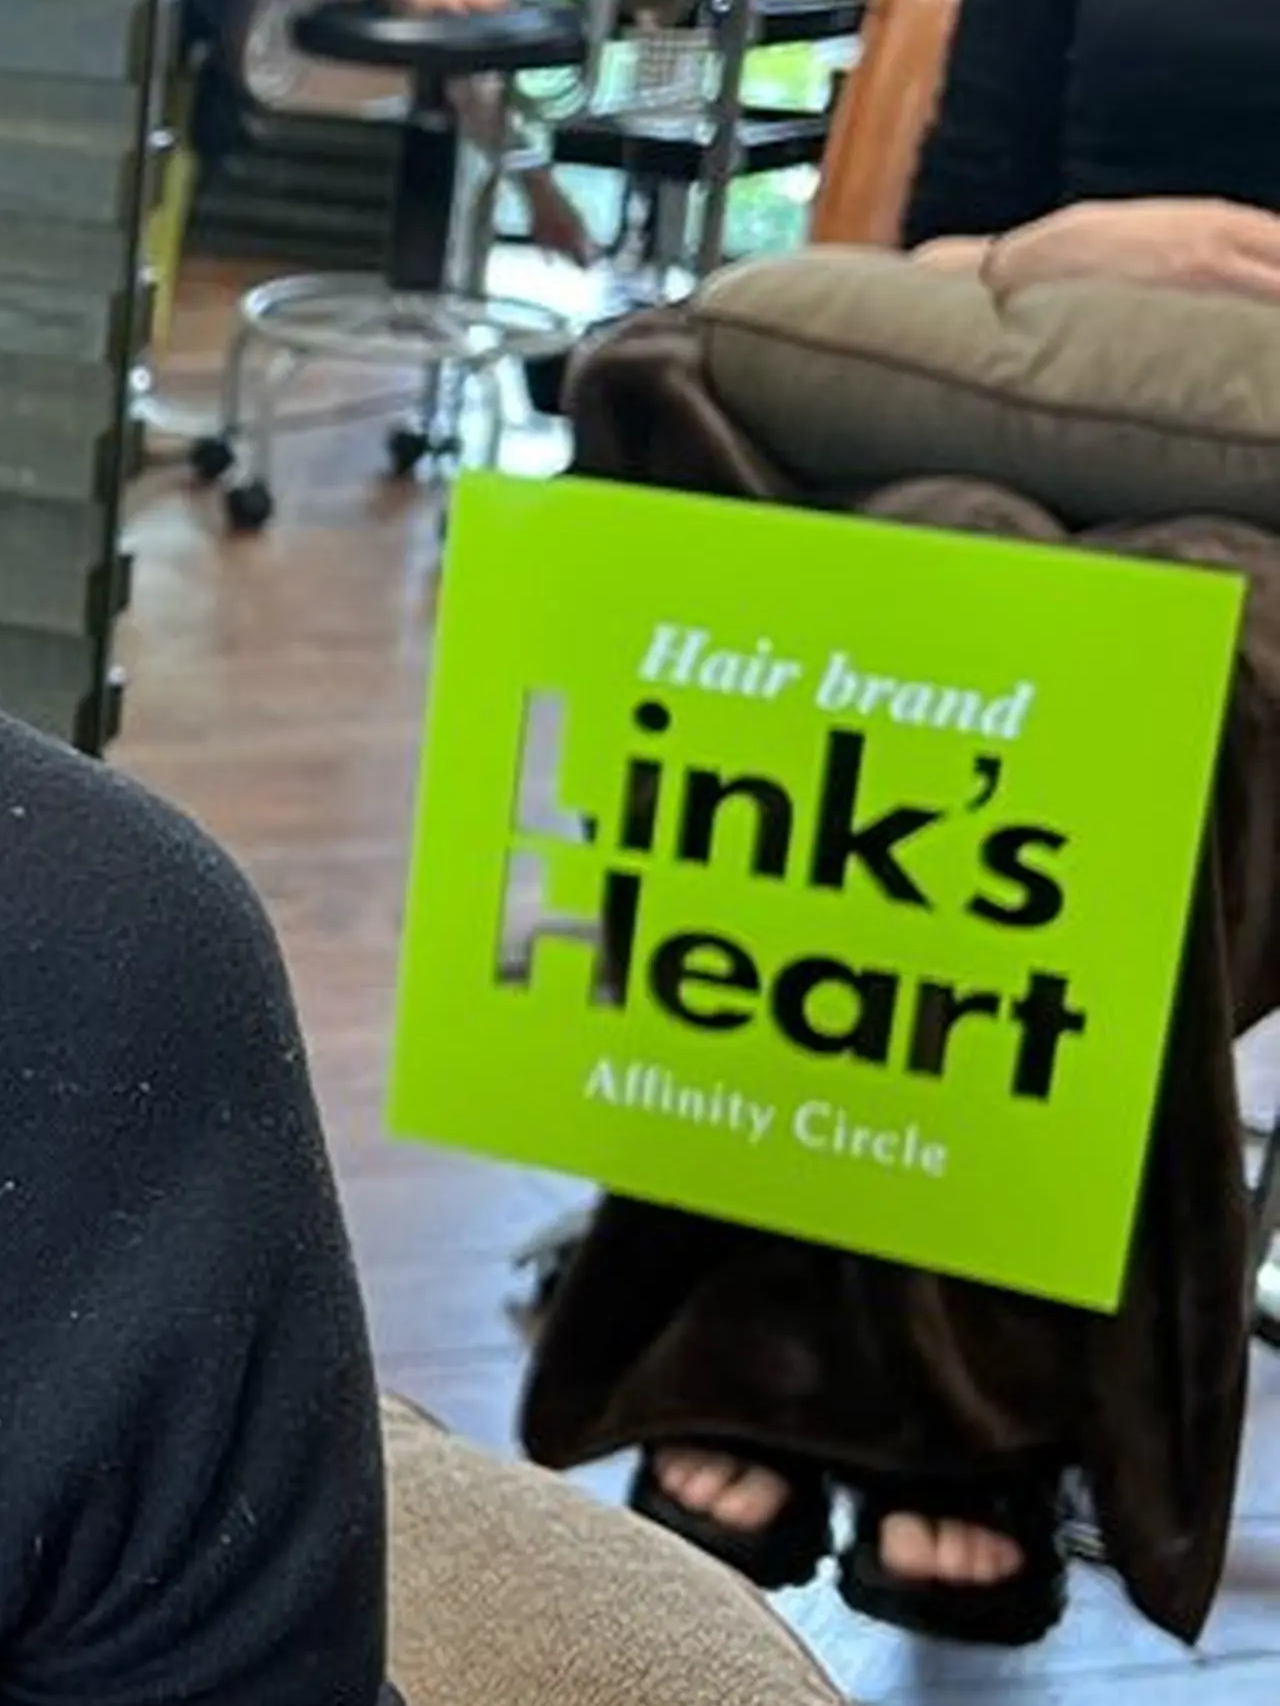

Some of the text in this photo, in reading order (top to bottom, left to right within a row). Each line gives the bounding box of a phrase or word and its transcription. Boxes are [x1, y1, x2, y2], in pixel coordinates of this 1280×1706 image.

[639, 623, 1035, 740] Hair brand
[514, 689, 1072, 929] Link's
[493, 848, 1088, 1101] Heart
[583, 1060, 949, 1177] Affinity Circle
